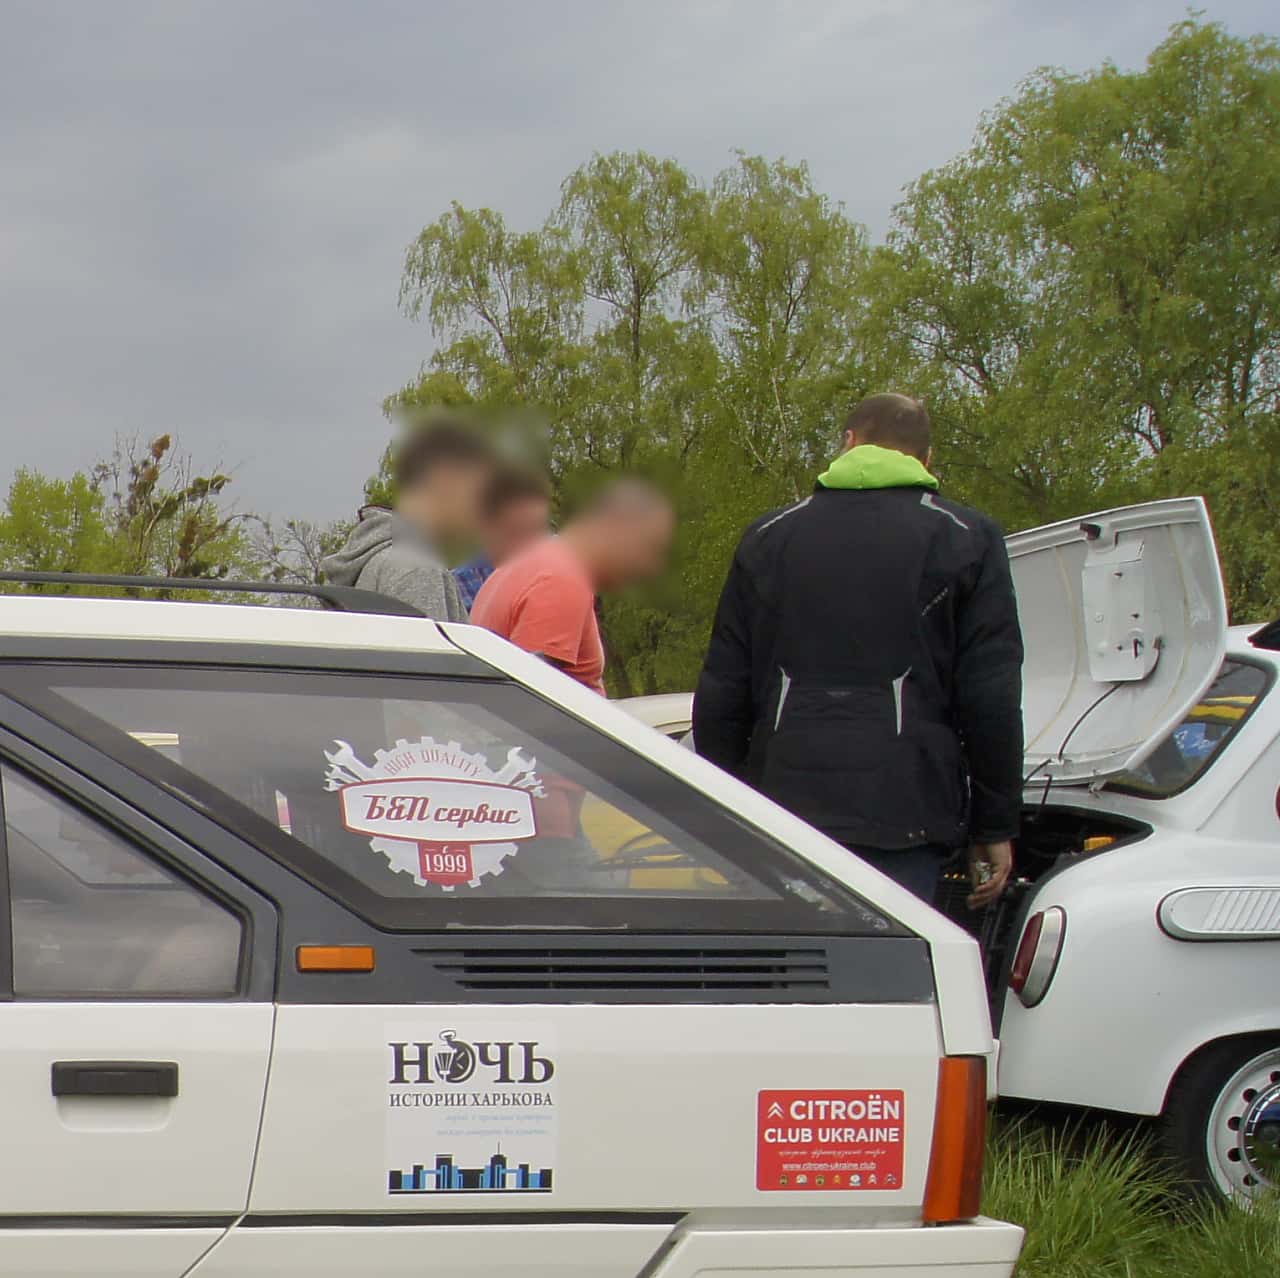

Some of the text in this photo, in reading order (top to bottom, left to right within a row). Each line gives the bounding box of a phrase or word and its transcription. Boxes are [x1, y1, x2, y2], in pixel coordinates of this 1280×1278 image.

[383, 749, 481, 776] HIGH QUALITY
[434, 803, 521, 828] сервис
[425, 854, 467, 872] 1999
[388, 1030, 555, 1084] НОЧЬ
[389, 1092, 554, 1107] ИСТОРИИ ХАРЬКОВА
[790, 1094, 900, 1120] CITROËN
[764, 1128, 900, 1143] CLUB UKRAINE
